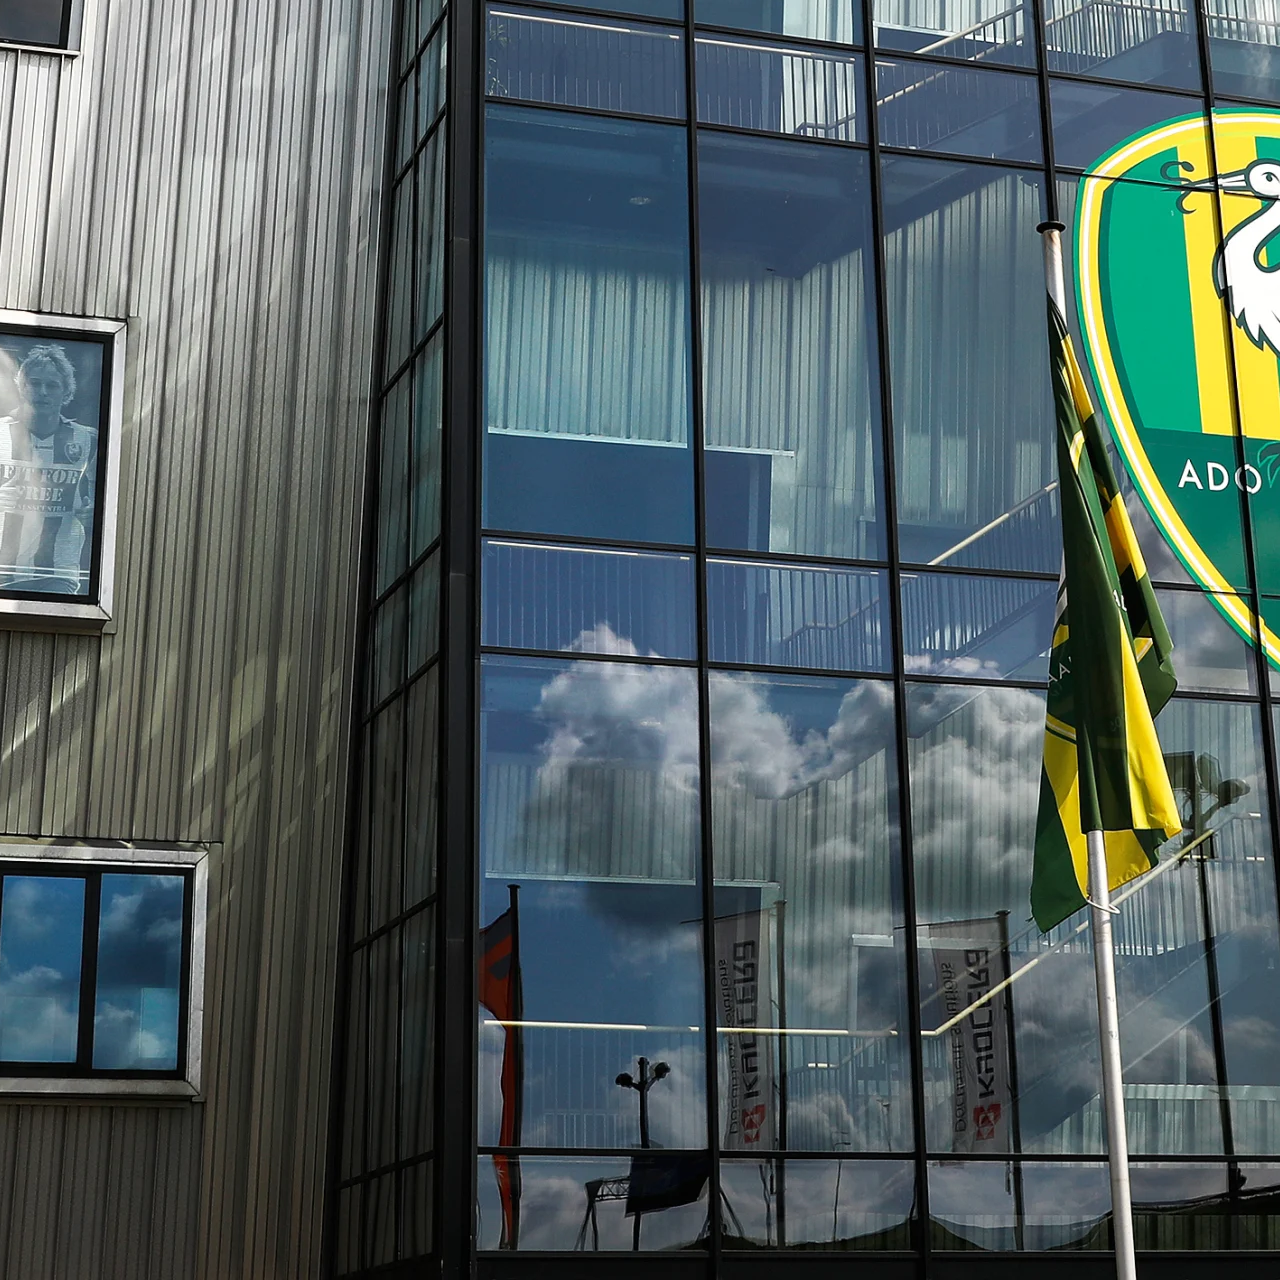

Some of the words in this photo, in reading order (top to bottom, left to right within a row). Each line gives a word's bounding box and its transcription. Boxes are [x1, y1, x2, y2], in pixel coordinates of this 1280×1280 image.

[40, 468, 80, 485] FOR
[1177, 458, 1263, 495] ADO
[15, 485, 64, 502] FREE
